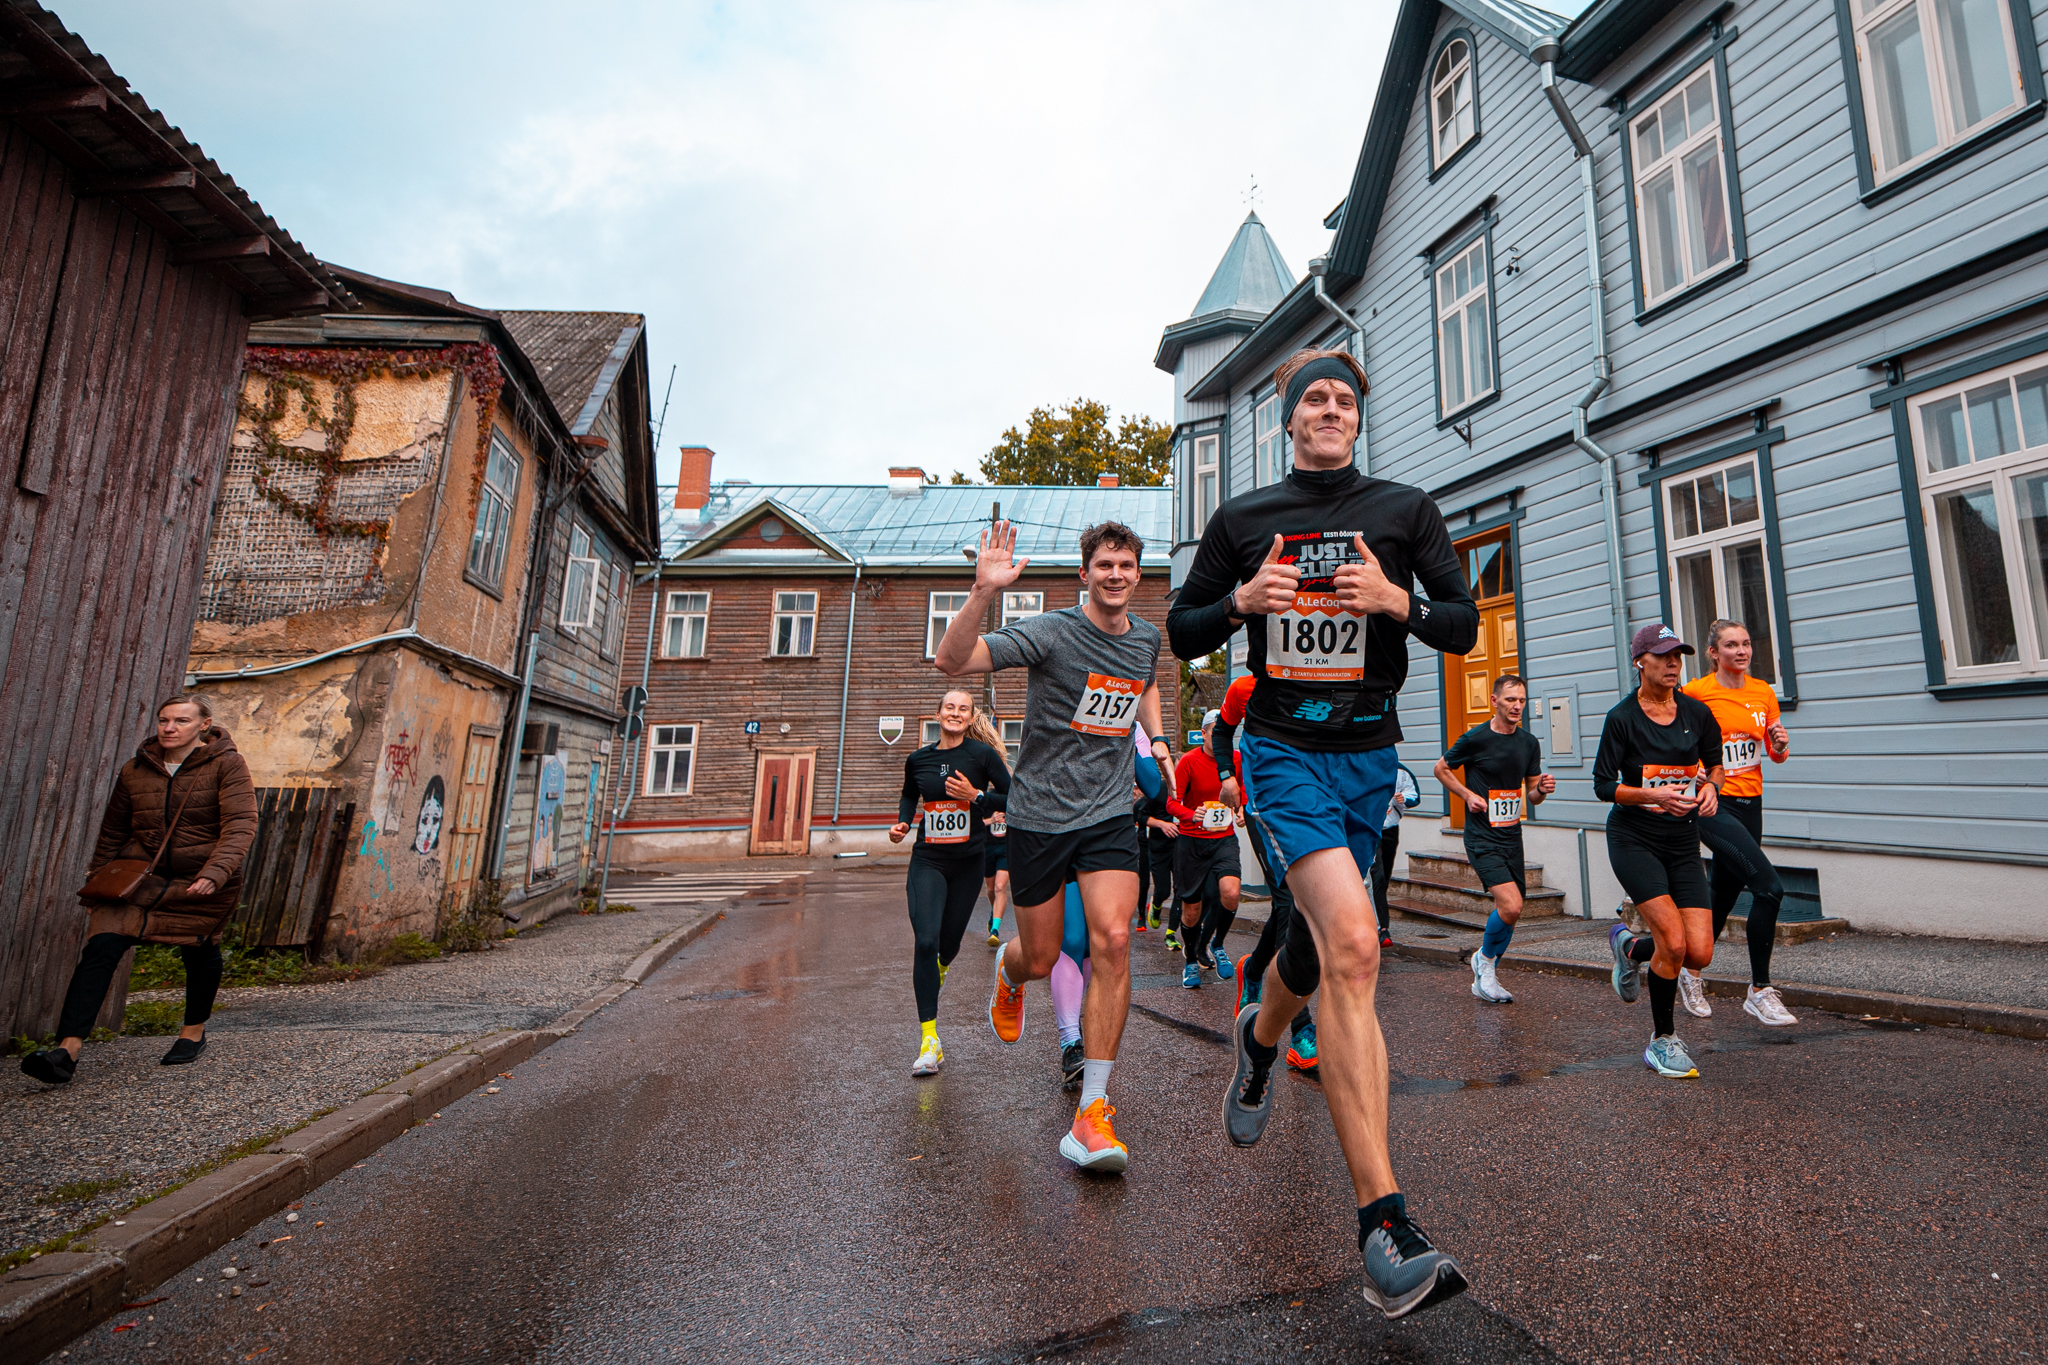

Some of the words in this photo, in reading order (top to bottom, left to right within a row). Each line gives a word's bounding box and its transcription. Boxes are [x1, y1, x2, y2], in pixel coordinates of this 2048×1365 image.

[1283, 534, 1305, 542] VIKING
[1306, 532, 1322, 541] LINE
[1323, 531, 1339, 539] EESTI
[1300, 543, 1348, 562] JUST
[1297, 596, 1341, 609] A.LeCoq
[1279, 618, 1360, 654] 1802
[1105, 680, 1132, 690] A.LeCoq
[1085, 692, 1136, 719] 2157
[1363, 714, 1382, 722] balance
[1751, 711, 1766, 727] 16
[747, 722, 758, 732] 42
[1724, 741, 1756, 763] 1149
[1660, 767, 1685, 775] A.LeCoq
[1495, 799, 1521, 816] 1317
[930, 812, 967, 832] 1680
[1213, 810, 1225, 822] 55
